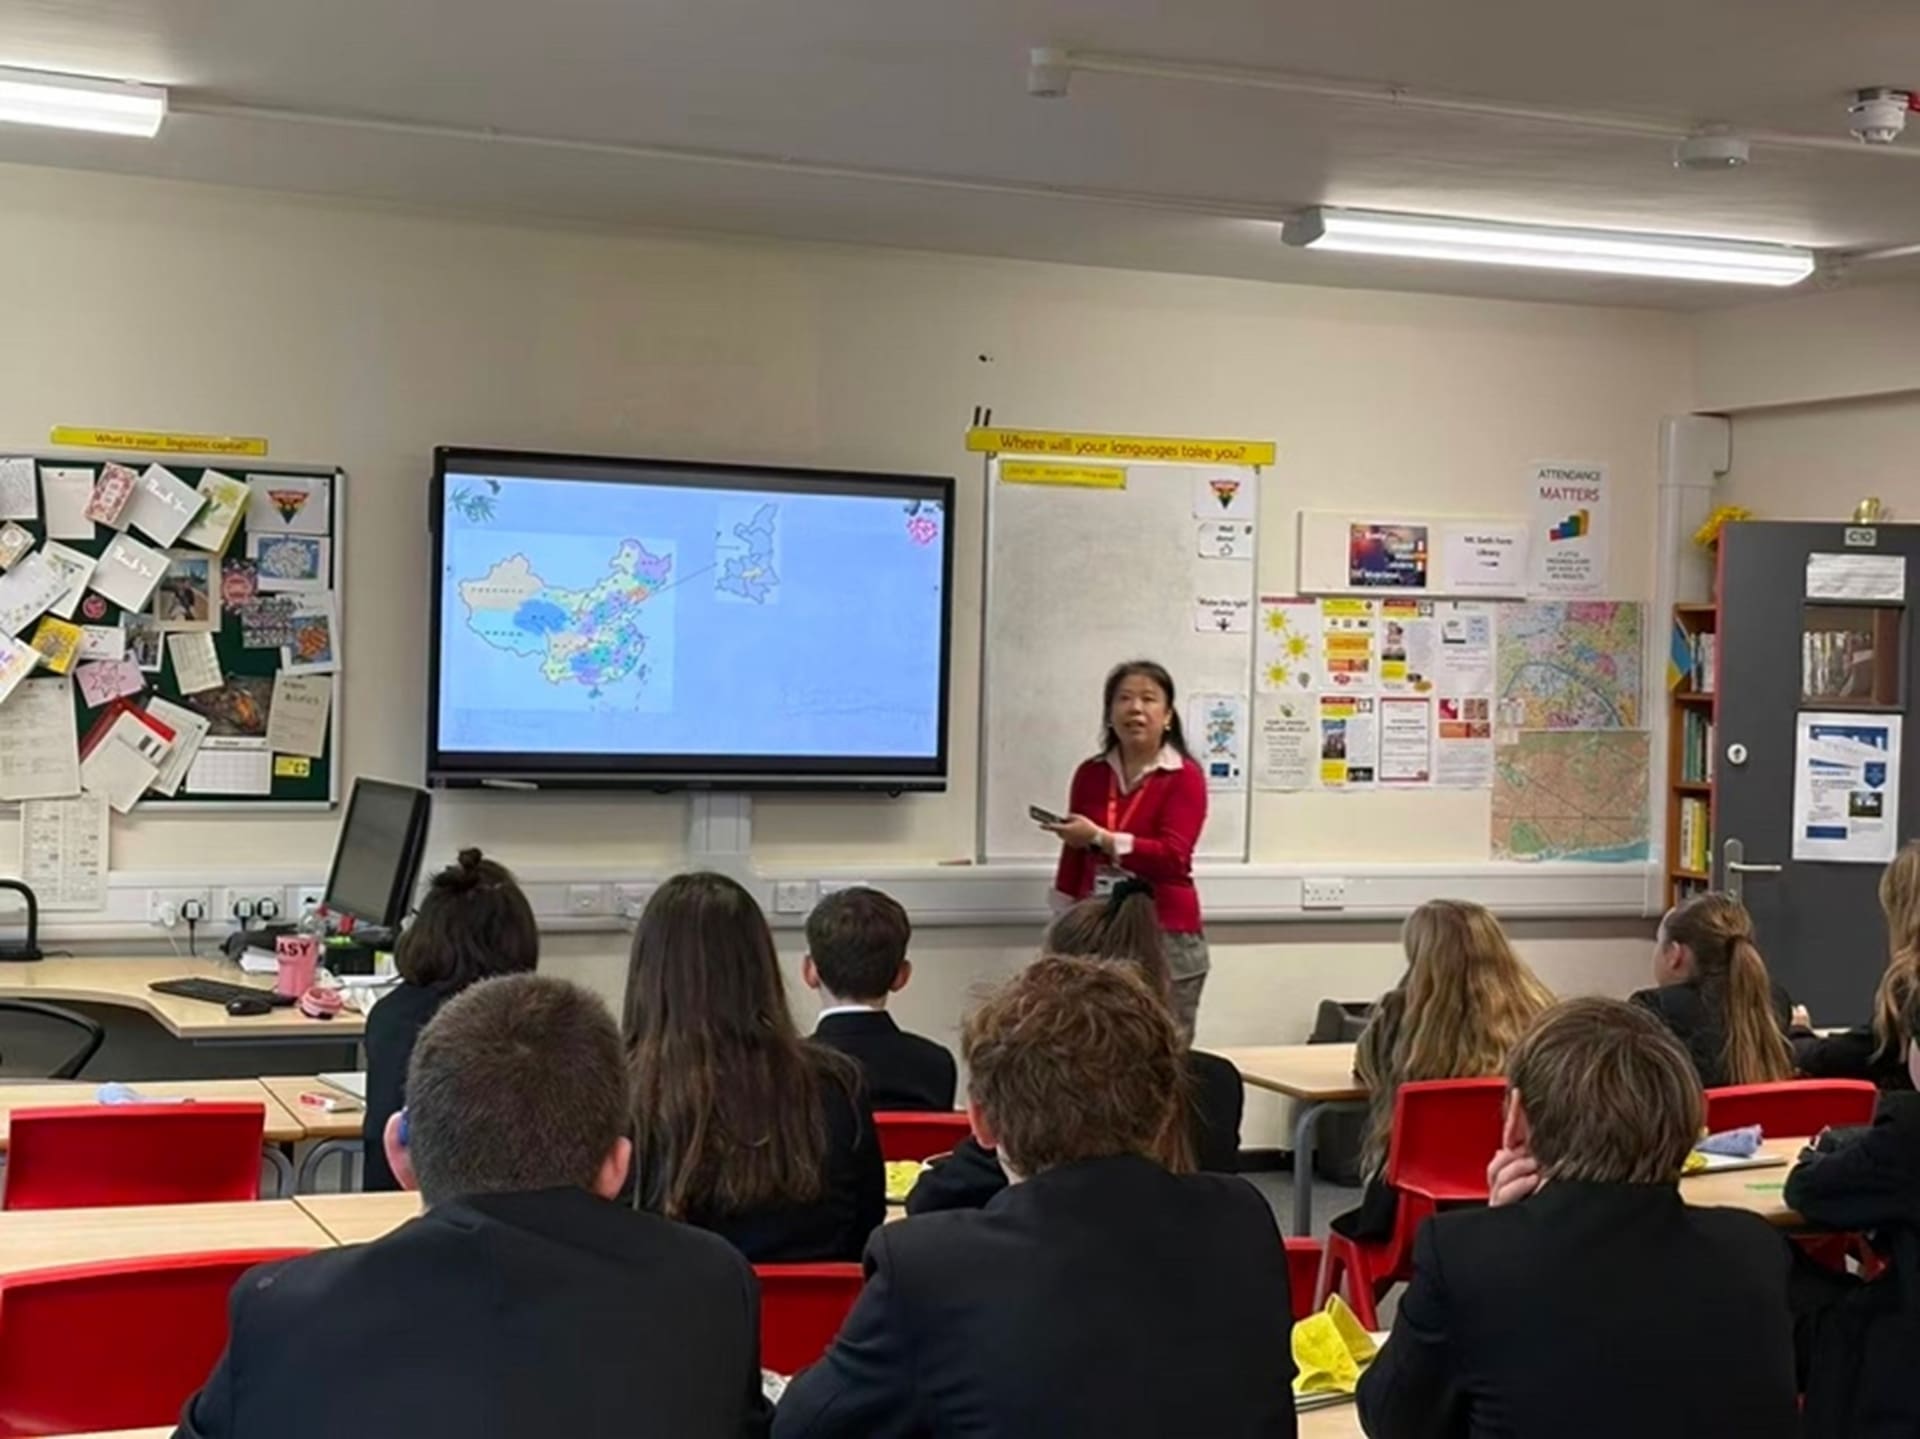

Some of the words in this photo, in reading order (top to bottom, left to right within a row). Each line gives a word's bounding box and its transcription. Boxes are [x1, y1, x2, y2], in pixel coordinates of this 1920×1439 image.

[95, 433, 122, 444] What
[124, 436, 133, 444] is
[134, 437, 157, 448] your
[165, 437, 210, 450] linguistic
[211, 440, 249, 452] capital?
[1000, 433, 1046, 450] Where
[1049, 437, 1072, 451] will
[1075, 440, 1107, 456] your
[1110, 439, 1178, 458] languages
[1181, 444, 1211, 457] take
[1215, 446, 1247, 461] you?
[1538, 468, 1601, 481] ATTENDANCE
[1540, 487, 1600, 501] MATTERS
